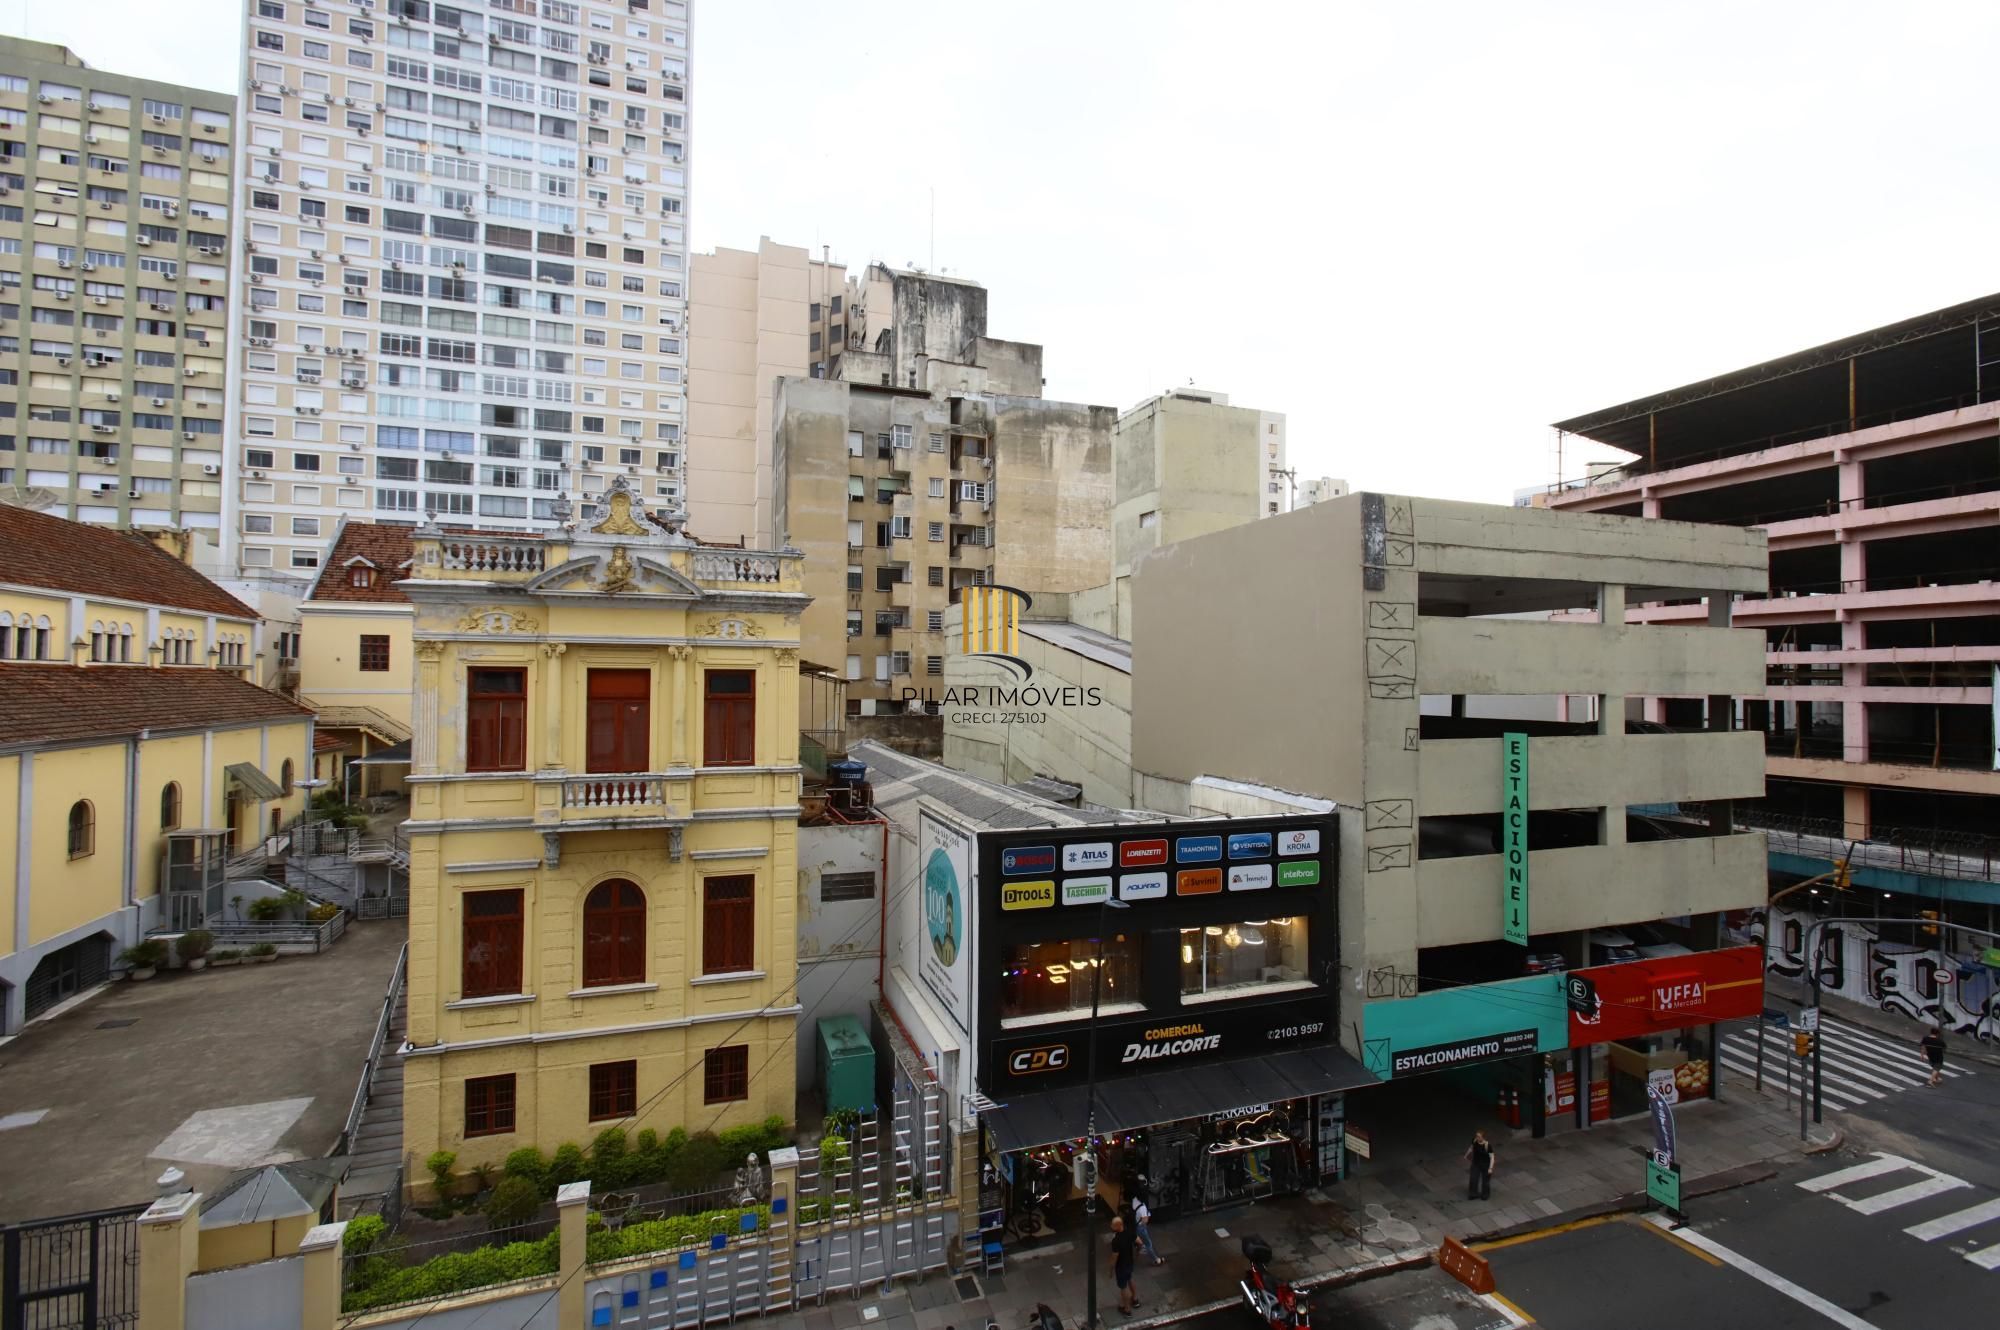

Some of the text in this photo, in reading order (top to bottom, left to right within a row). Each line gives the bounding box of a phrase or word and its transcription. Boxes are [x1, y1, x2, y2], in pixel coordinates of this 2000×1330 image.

[1509, 741, 1522, 901] ESTACIONE
[1126, 848, 1162, 858] LORENZETTI
[1180, 845, 1218, 853] TRAMONTINA
[1286, 842, 1311, 850] KRONA
[1081, 850, 1108, 860] ATLAS
[1190, 876, 1218, 887] Suvinil
[1283, 870, 1314, 879] intelbras
[1065, 884, 1108, 898] TASCHIBRA
[928, 887, 945, 925] 100
[1573, 982, 1583, 996] E
[1657, 982, 1702, 1003] UFFA
[1673, 998, 1702, 1008] Mercado
[1145, 1023, 1205, 1041] COMERCIAL
[1274, 1022, 1324, 1040] 2103 9597
[1121, 1034, 1222, 1063] DALACORTE
[1013, 1048, 1065, 1070] CDC
[1395, 1041, 1500, 1071] ESTACIONAMENTO
